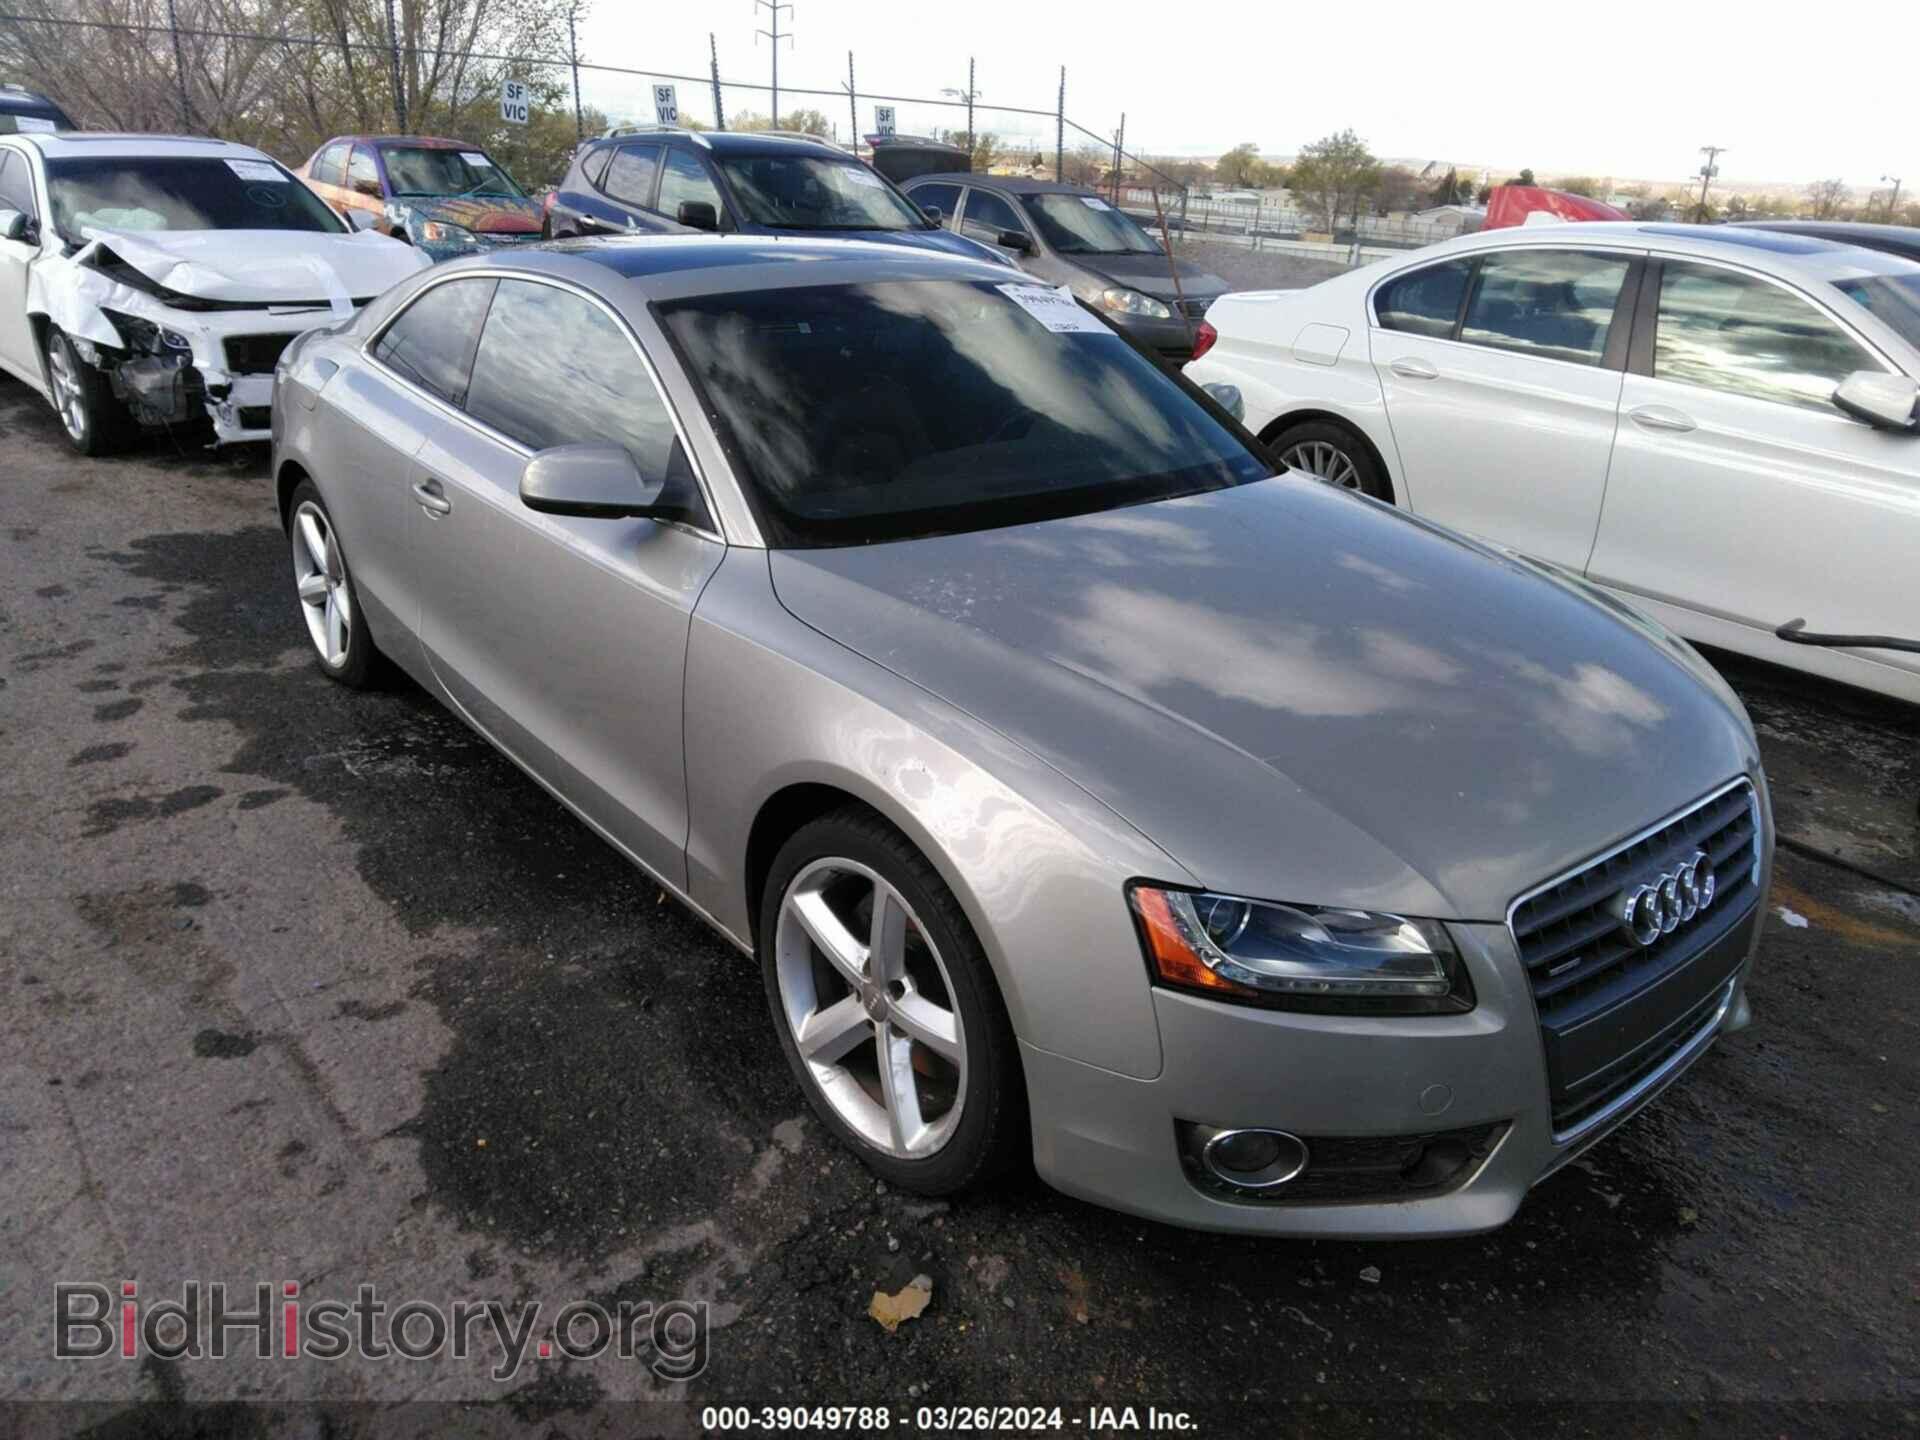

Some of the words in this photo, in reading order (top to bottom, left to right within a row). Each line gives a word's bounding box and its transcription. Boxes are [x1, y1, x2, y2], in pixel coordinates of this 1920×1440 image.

[507, 83, 524, 100] SF
[657, 87, 672, 103] SF
[503, 102, 526, 121] VIC
[657, 106, 677, 123] VIC
[879, 109, 891, 122] SF
